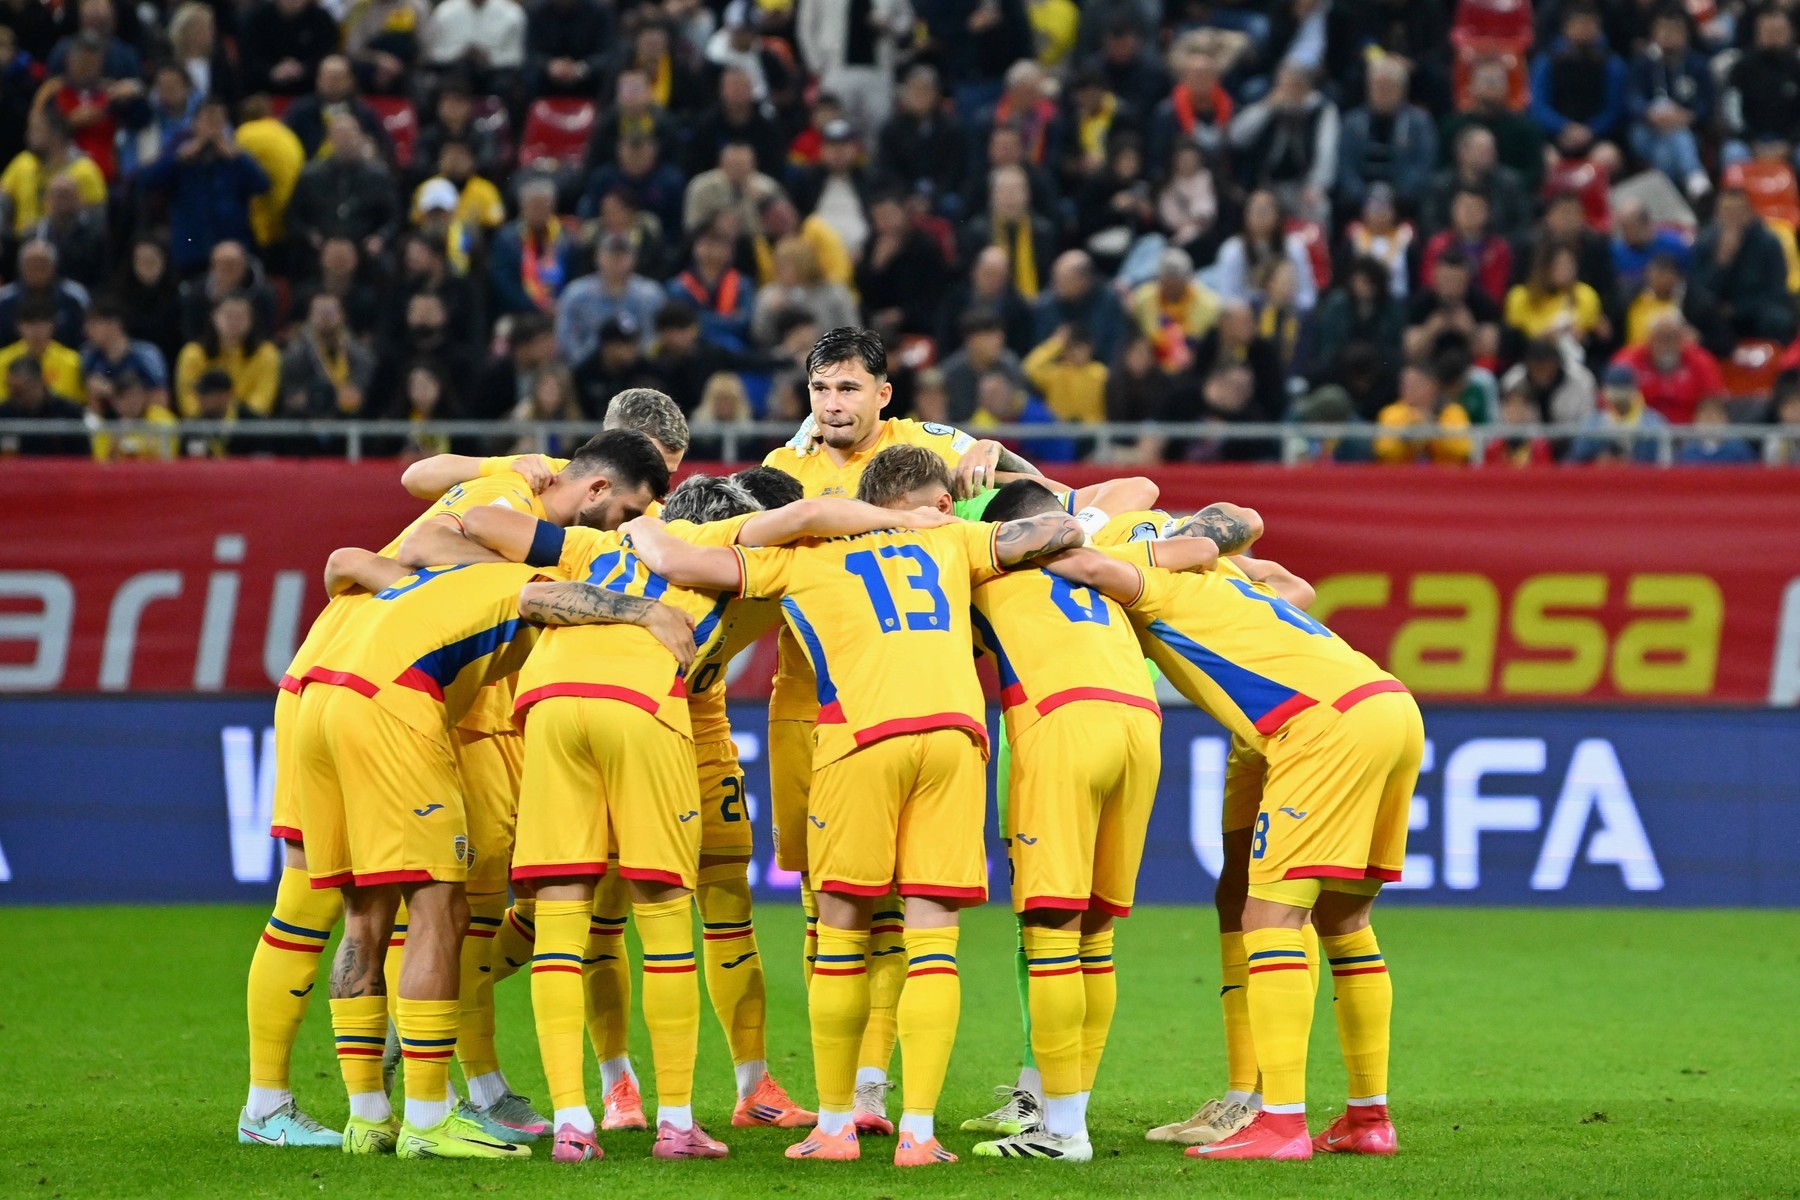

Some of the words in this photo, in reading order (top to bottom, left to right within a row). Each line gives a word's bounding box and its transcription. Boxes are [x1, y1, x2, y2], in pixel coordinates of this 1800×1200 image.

[845, 545, 950, 633] 13
[691, 662, 722, 694] 0
[1189, 737, 1665, 891] FA
